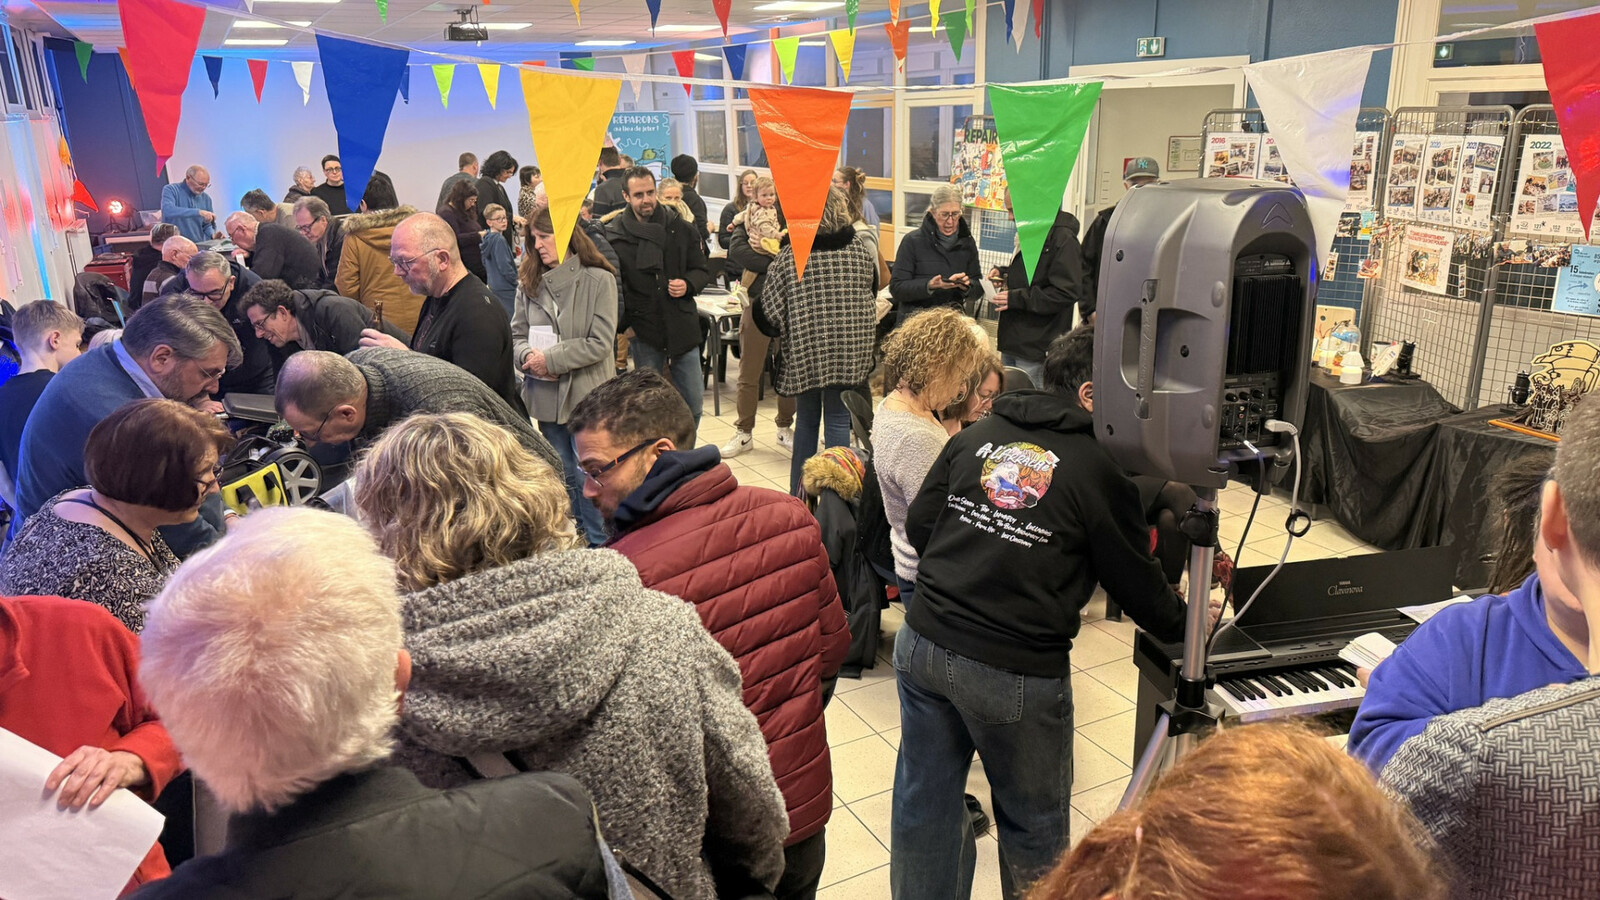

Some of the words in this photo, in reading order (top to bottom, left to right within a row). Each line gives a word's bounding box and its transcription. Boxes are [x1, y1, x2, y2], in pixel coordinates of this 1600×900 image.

[612, 114, 659, 124] RÉPARONS
[642, 125, 655, 133] jeter
[964, 129, 998, 144] REPAIR
[1530, 141, 1552, 149] 2022
[1570, 264, 1579, 274] 15
[976, 442, 993, 459] A
[1327, 585, 1363, 596] Clavinova
